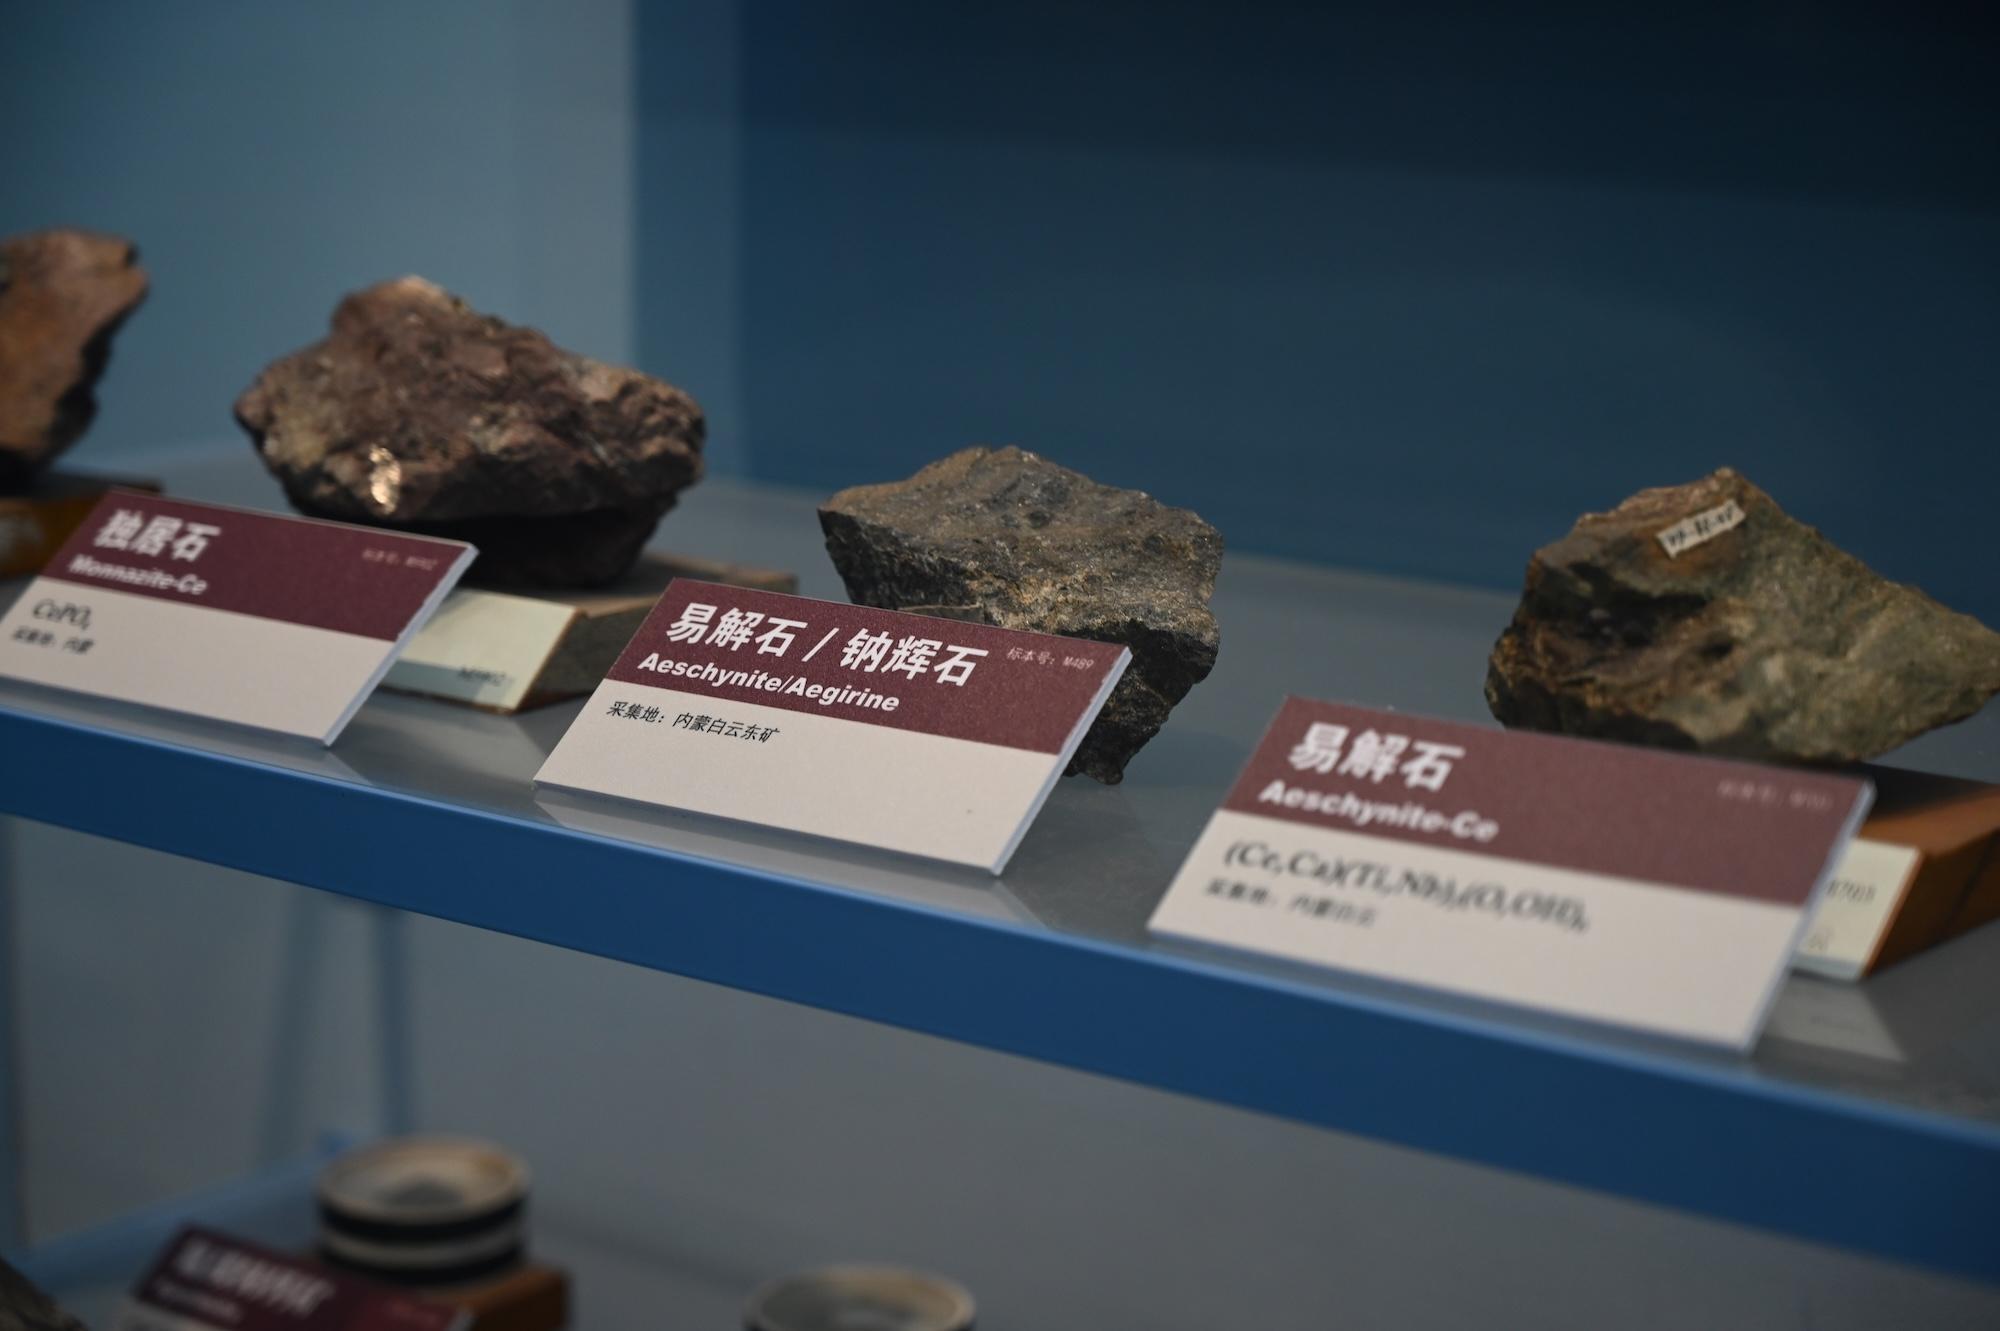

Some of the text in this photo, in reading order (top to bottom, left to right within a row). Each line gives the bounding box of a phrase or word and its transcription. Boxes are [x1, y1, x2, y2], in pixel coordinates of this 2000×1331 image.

[666, 602, 808, 660] 易解石
[838, 628, 989, 687] 钠辉石
[637, 652, 901, 713] Aeschynite/Aegirine
[606, 700, 782, 745] 采集地：内蒙白云东矿
[1289, 722, 1465, 794] 易解石
[1259, 779, 1499, 843] Aeschynite-Ce
